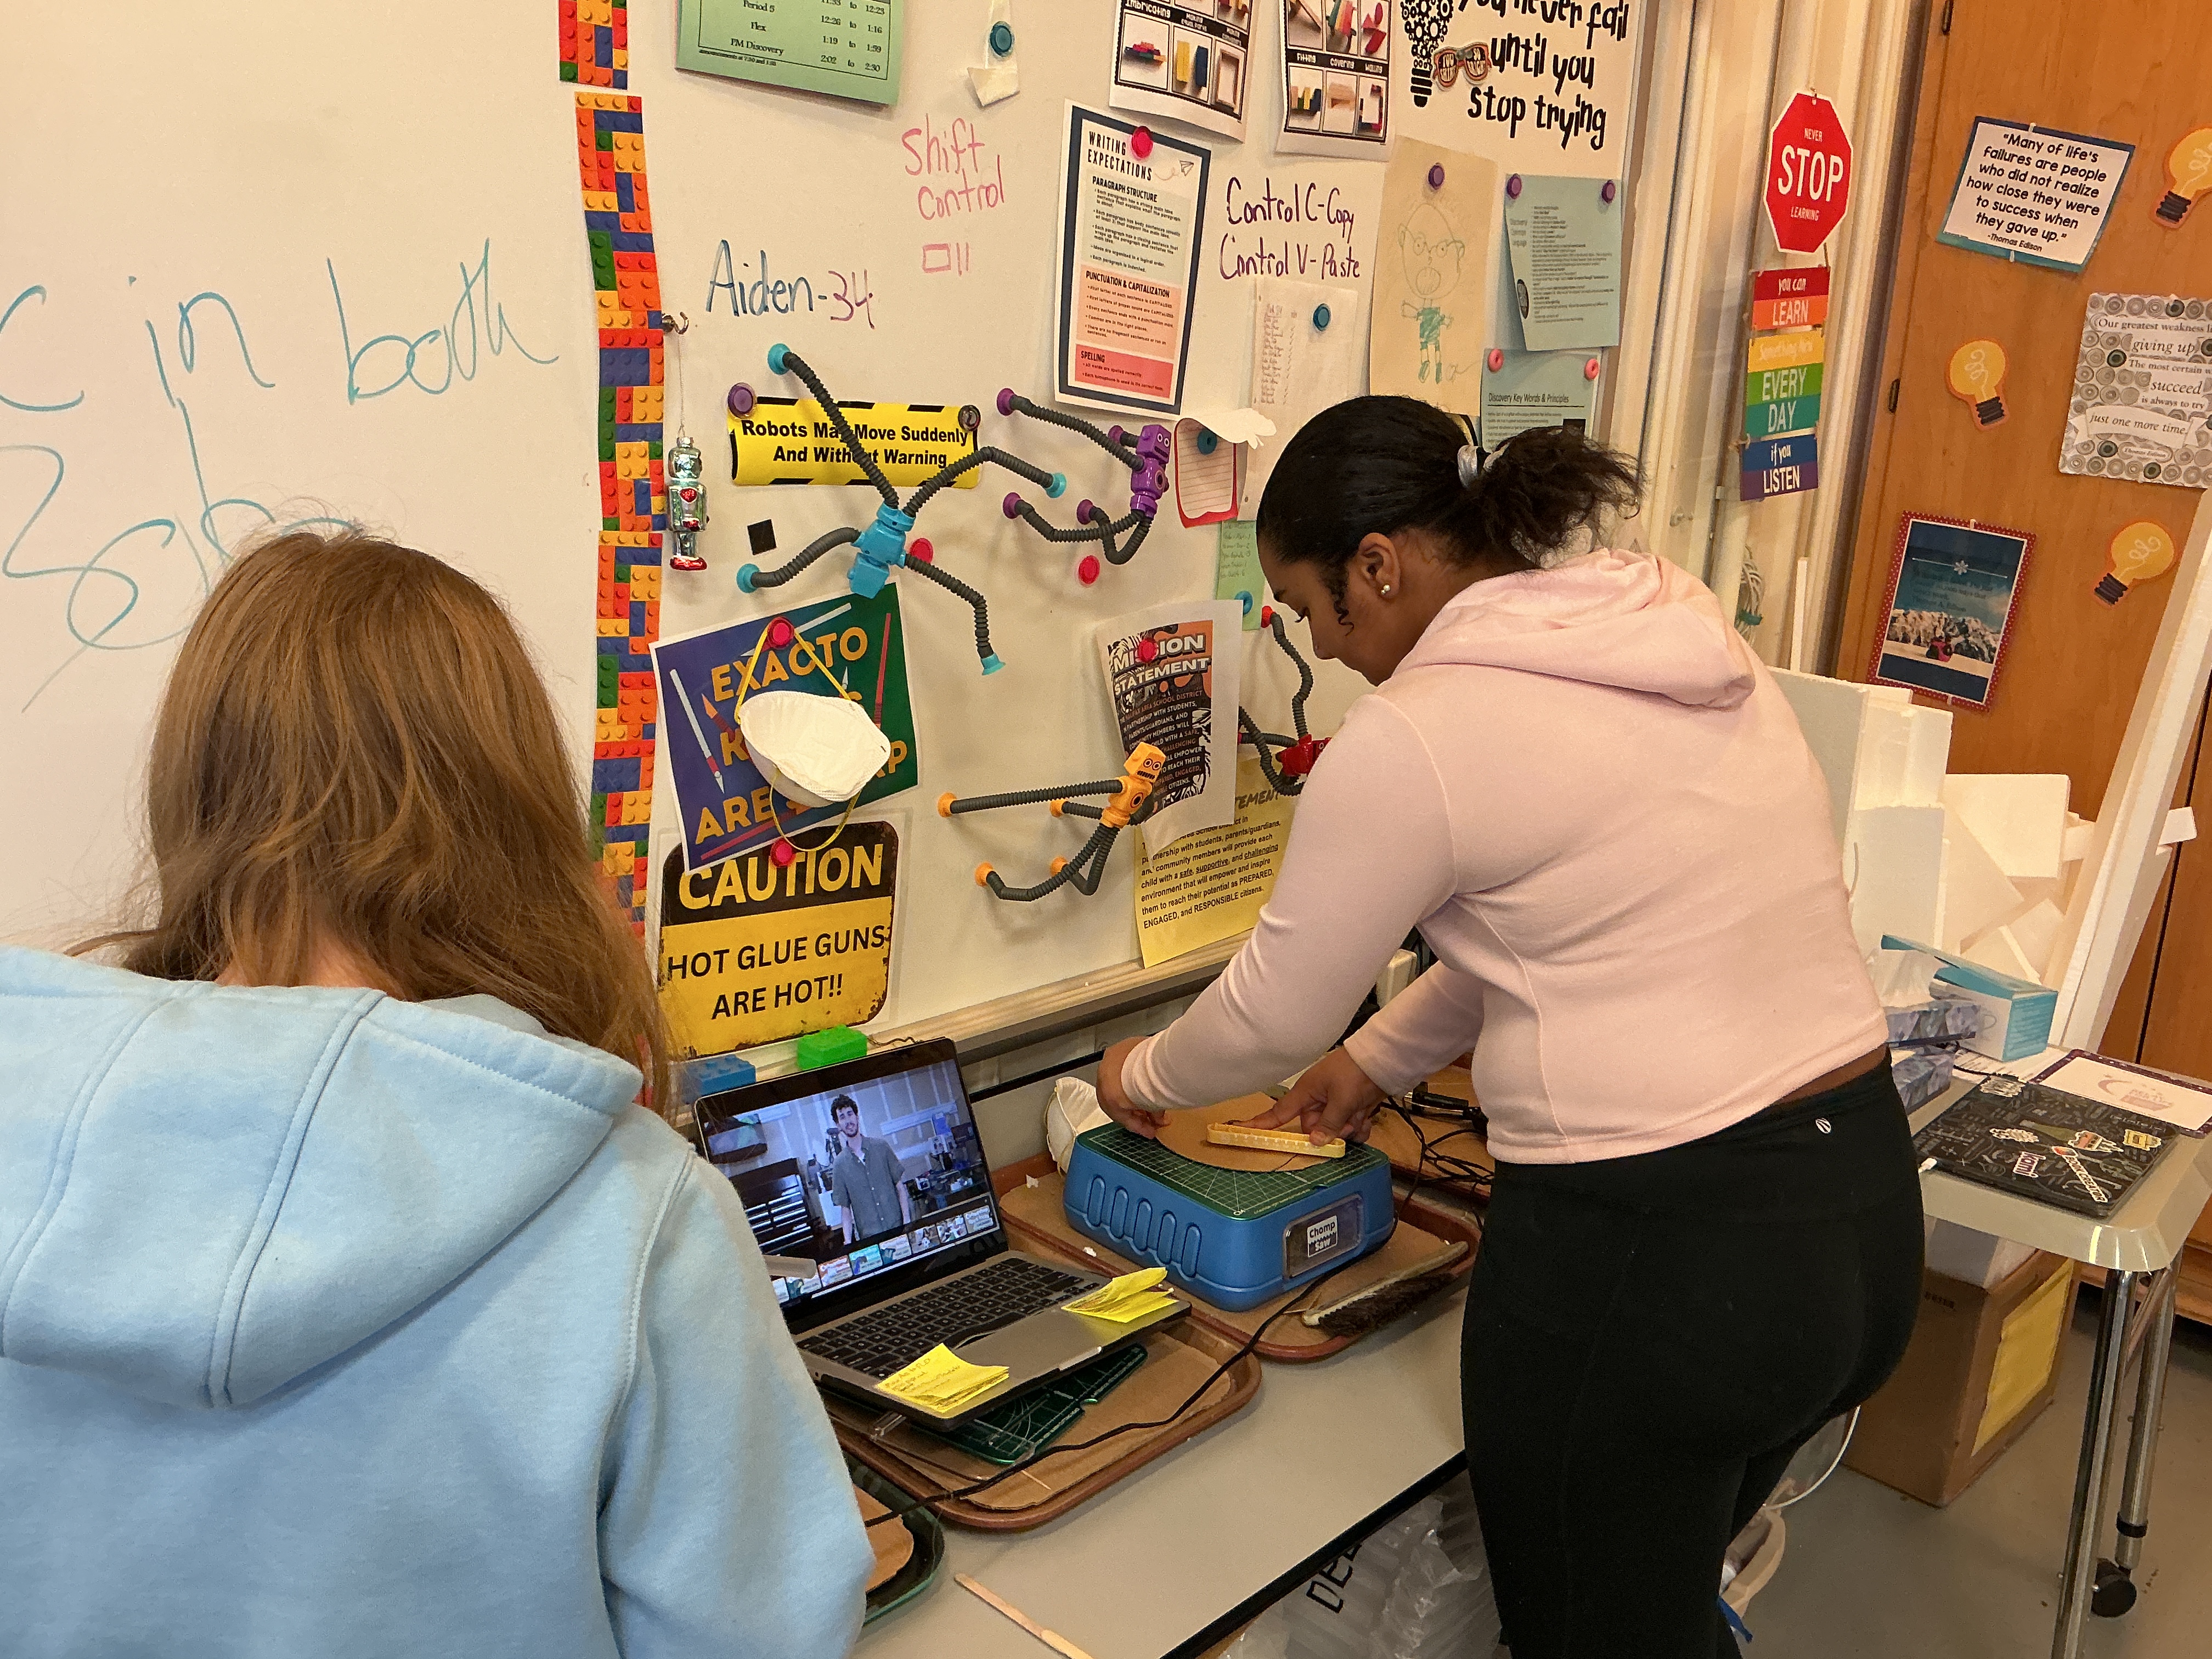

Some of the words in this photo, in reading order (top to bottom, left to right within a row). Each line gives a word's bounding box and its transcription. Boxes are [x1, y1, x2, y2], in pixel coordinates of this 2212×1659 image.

[743, 0, 768, 12] Period
[867, 25, 882, 33] 1:16
[866, 5, 885, 15] 12:23
[751, 22, 766, 31] Flex
[1587, 0, 1629, 49] fail
[731, 38, 743, 47] PM
[746, 41, 784, 55] Discovery
[820, 55, 837, 64] 2:02
[1491, 33, 1548, 77] until
[1553, 54, 1595, 96] you
[1468, 86, 1526, 138] stop
[1534, 94, 1606, 150] trying
[901, 113, 985, 176] Shift
[1089, 131, 1126, 156] WRITING
[1803, 127, 1823, 142] NEVER
[1088, 149, 1152, 181] EXPECTATIONS
[1983, 145, 2032, 166] failures
[2035, 159, 2058, 171] are
[2060, 165, 2107, 182] people
[2047, 144, 2064, 155] of
[2065, 145, 2099, 163] life's
[1778, 145, 1844, 202] STOP
[1979, 163, 2005, 177] who
[2008, 168, 2029, 182] did
[2029, 175, 2052, 187] not
[2054, 180, 2099, 198] realize
[1092, 176, 1126, 192] PARAGRAPH
[1126, 187, 1158, 202] STRUCTURE
[1227, 177, 1300, 224] Control
[1966, 176, 1994, 191] how
[1996, 183, 2029, 199] close
[2033, 190, 2062, 209] they
[2066, 200, 2100, 216] were
[1791, 206, 1820, 221] LEARNING
[1976, 195, 1989, 207] to
[1992, 201, 2041, 220] success
[2045, 213, 2078, 230] when
[1976, 212, 2005, 231] they
[2005, 222, 2039, 236] gave
[1220, 233, 1289, 280] Control
[2019, 240, 2042, 252] Edison
[1086, 270, 1122, 287] PUNCTUATION
[1123, 280, 1127, 289] &
[1128, 281, 1170, 298] CAPITALIZATION
[1778, 278, 1791, 296] you
[1792, 278, 1806, 292] can
[1773, 300, 1809, 326] LEARN
[2098, 318, 2119, 328] Our
[2162, 323, 2204, 331] weakness
[1081, 351, 1105, 363] SPELLING
[2131, 338, 2174, 355] giving
[2177, 343, 2195, 357] up
[2129, 359, 2146, 368] The
[2148, 363, 2169, 371] most
[2172, 365, 2202, 374] certain
[1762, 367, 1807, 401] EVERY
[2150, 381, 2203, 394] succeed
[1489, 392, 1512, 404] Discovery
[1514, 394, 1523, 404] Key
[2149, 396, 2177, 407] always
[1768, 400, 1797, 432] DAY
[2089, 413, 2109, 424] just
[2112, 417, 2131, 426] one
[2134, 421, 2159, 431] more
[741, 420, 808, 438] Robots
[814, 422, 854, 442] Ma
[854, 424, 896, 441] Move
[901, 426, 968, 447] Suddenly
[774, 446, 808, 462] And
[814, 447, 878, 463] Witht
[884, 449, 947, 469] Warning
[1771, 443, 1778, 466] if
[1778, 444, 1791, 465] you
[1763, 465, 1801, 493] LISTEN
[711, 627, 868, 702] EXACTO
[1114, 635, 1205, 673] MIION
[1114, 658, 1210, 696] STATEMENT
[1176, 690, 1203, 701] DISTRICT
[1176, 712, 1188, 720] AND
[1176, 721, 1189, 729] WILL
[1174, 747, 1203, 758] EMPOWER
[1185, 756, 1201, 765] THEIR
[695, 787, 775, 845] ARE
[1181, 842, 1195, 853] with
[1195, 835, 1223, 848] students,
[1225, 820, 1281, 842] parents/guardians,
[1141, 878, 1158, 889] child
[1159, 874, 1173, 883] with
[1179, 868, 1194, 879] safe,
[1195, 859, 1231, 874] supportive,
[1232, 855, 1243, 866] and
[1244, 843, 1279, 860] challenging
[1155, 856, 1191, 872] community
[1192, 848, 1221, 862] members
[1222, 843, 1233, 852] will
[1234, 837, 1256, 852] provide
[1258, 833, 1273, 843] each
[679, 844, 884, 910] CAUTION
[1141, 884, 1182, 902] environment
[1183, 879, 1196, 889] that
[1197, 875, 1207, 885] will
[1209, 868, 1237, 883] empower
[1238, 862, 1249, 873] and
[1250, 857, 1271, 871] inspire
[1142, 905, 1159, 916] them
[1168, 896, 1186, 907] reach
[1187, 890, 1202, 901] their
[1203, 881, 1229, 898] potential
[1239, 868, 1274, 886] PREPARED,
[1144, 911, 1180, 929] ENGAGED,
[1181, 906, 1193, 917] and
[1194, 891, 1239, 913] RESPONSIBLE
[1240, 885, 1265, 897] citizens.
[668, 949, 730, 980] HOT
[737, 936, 807, 970] GLUE
[815, 925, 887, 957] GUNS
[712, 988, 766, 1020] ARE
[774, 973, 843, 1008] HOT!!
[1310, 1221, 1335, 1238] Chomp
[1315, 1238, 1331, 1251] saw
